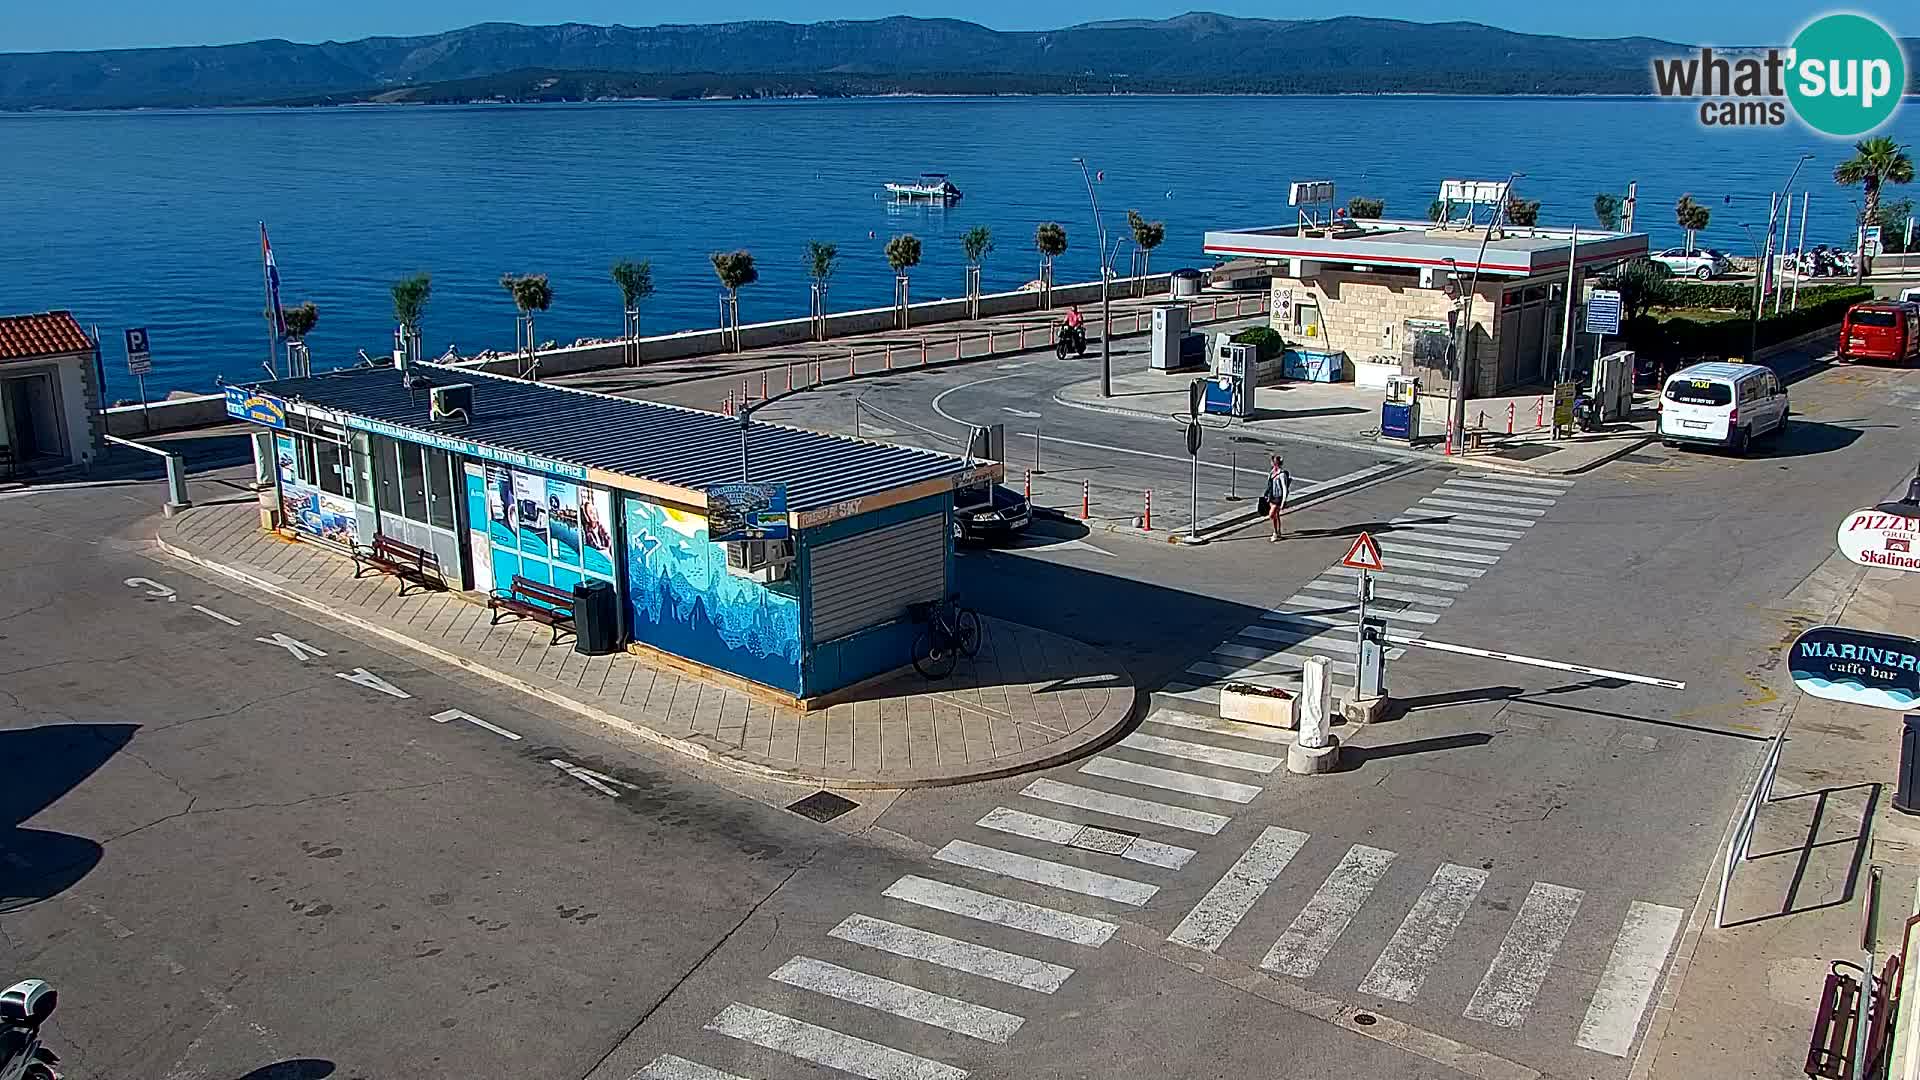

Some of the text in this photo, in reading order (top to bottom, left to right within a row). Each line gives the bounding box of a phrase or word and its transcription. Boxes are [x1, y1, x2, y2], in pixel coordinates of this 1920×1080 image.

[130, 331, 143, 350] P
[1691, 381, 1710, 389] TAXI
[437, 437, 468, 452] POSTAJA
[478, 447, 493, 458] BUS
[493, 449, 527, 465] STATION
[528, 457, 554, 471] TICKET
[555, 463, 583, 479] OFFICE
[1848, 515, 1920, 533] PIZZE
[1882, 531, 1917, 540] GRILL
[1829, 662, 1897, 680] caffe bar
